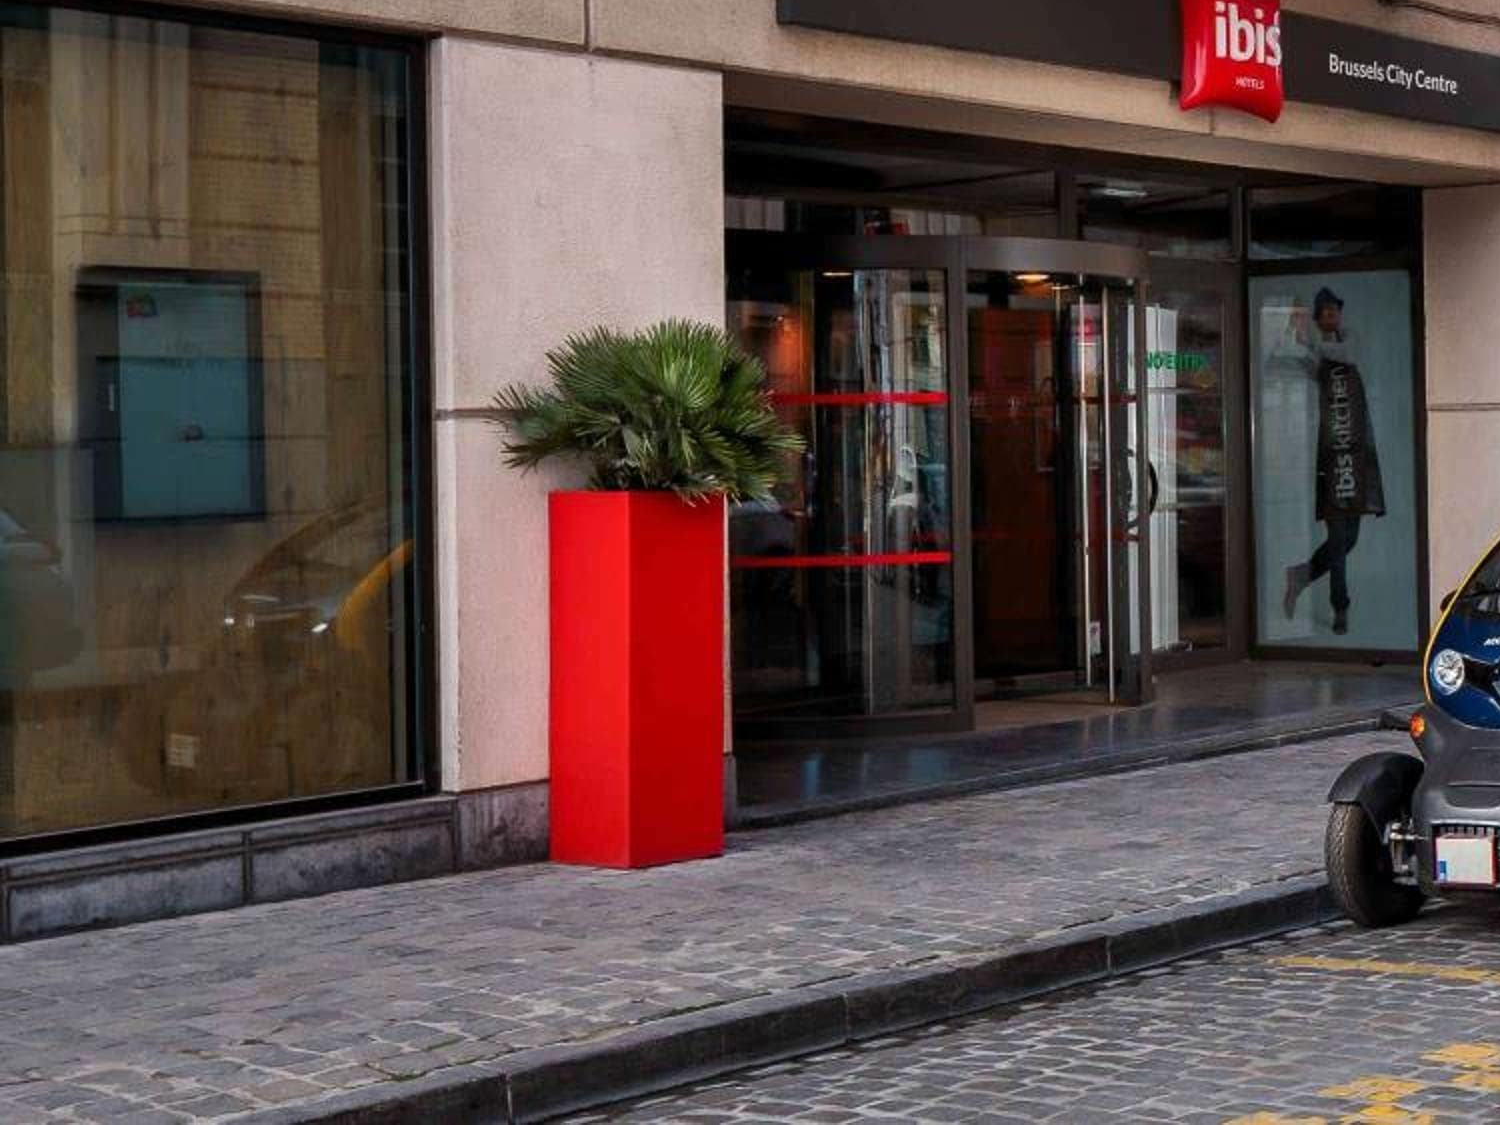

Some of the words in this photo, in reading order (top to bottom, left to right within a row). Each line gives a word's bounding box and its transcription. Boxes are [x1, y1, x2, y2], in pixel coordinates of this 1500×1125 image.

[1215, 0, 1282, 67] ibis
[1329, 53, 1385, 82] Brussels
[1386, 63, 1413, 90] City
[1414, 69, 1458, 94] Centre
[1330, 364, 1351, 451] kitchen
[1334, 453, 1356, 499] ibis
